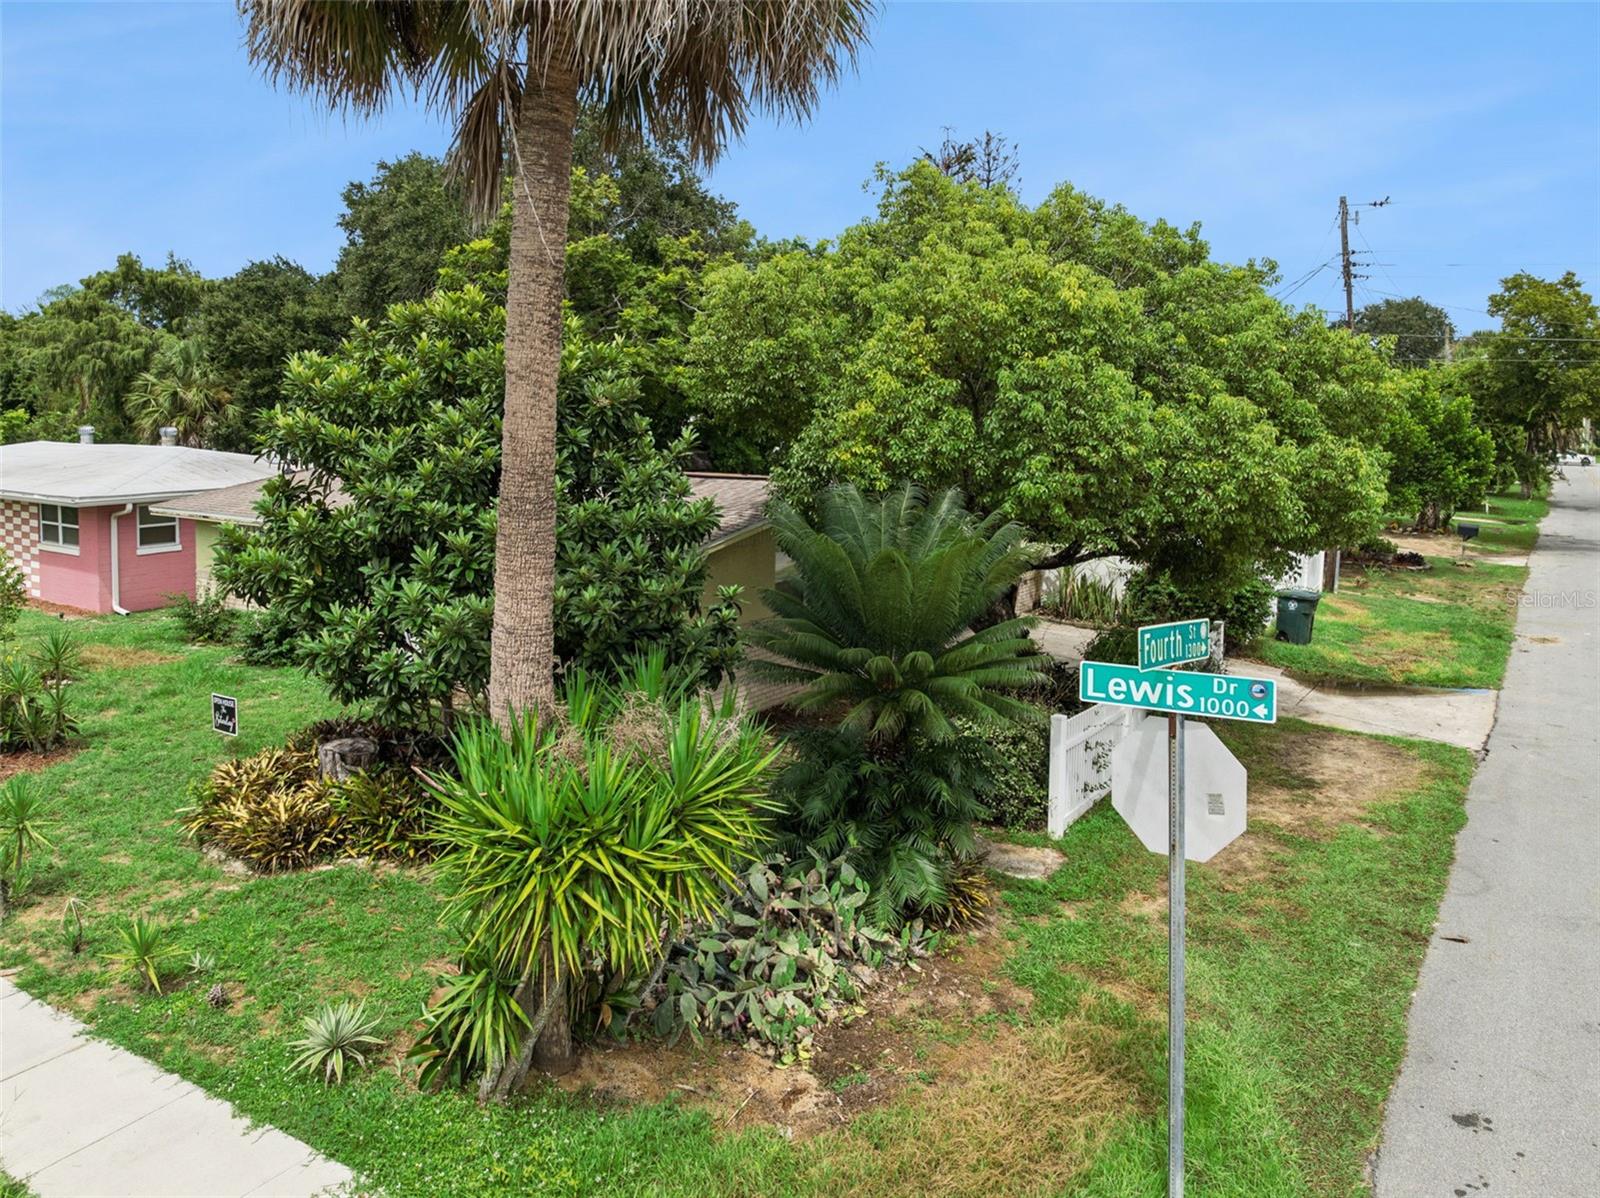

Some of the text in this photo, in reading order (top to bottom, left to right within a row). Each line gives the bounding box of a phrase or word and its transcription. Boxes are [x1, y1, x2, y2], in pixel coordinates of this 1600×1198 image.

[1144, 624, 1196, 664] Fourth St
[1185, 641, 1202, 658] 1300
[1087, 668, 1238, 708] Lewis Dr
[1200, 697, 1249, 717] 1000
